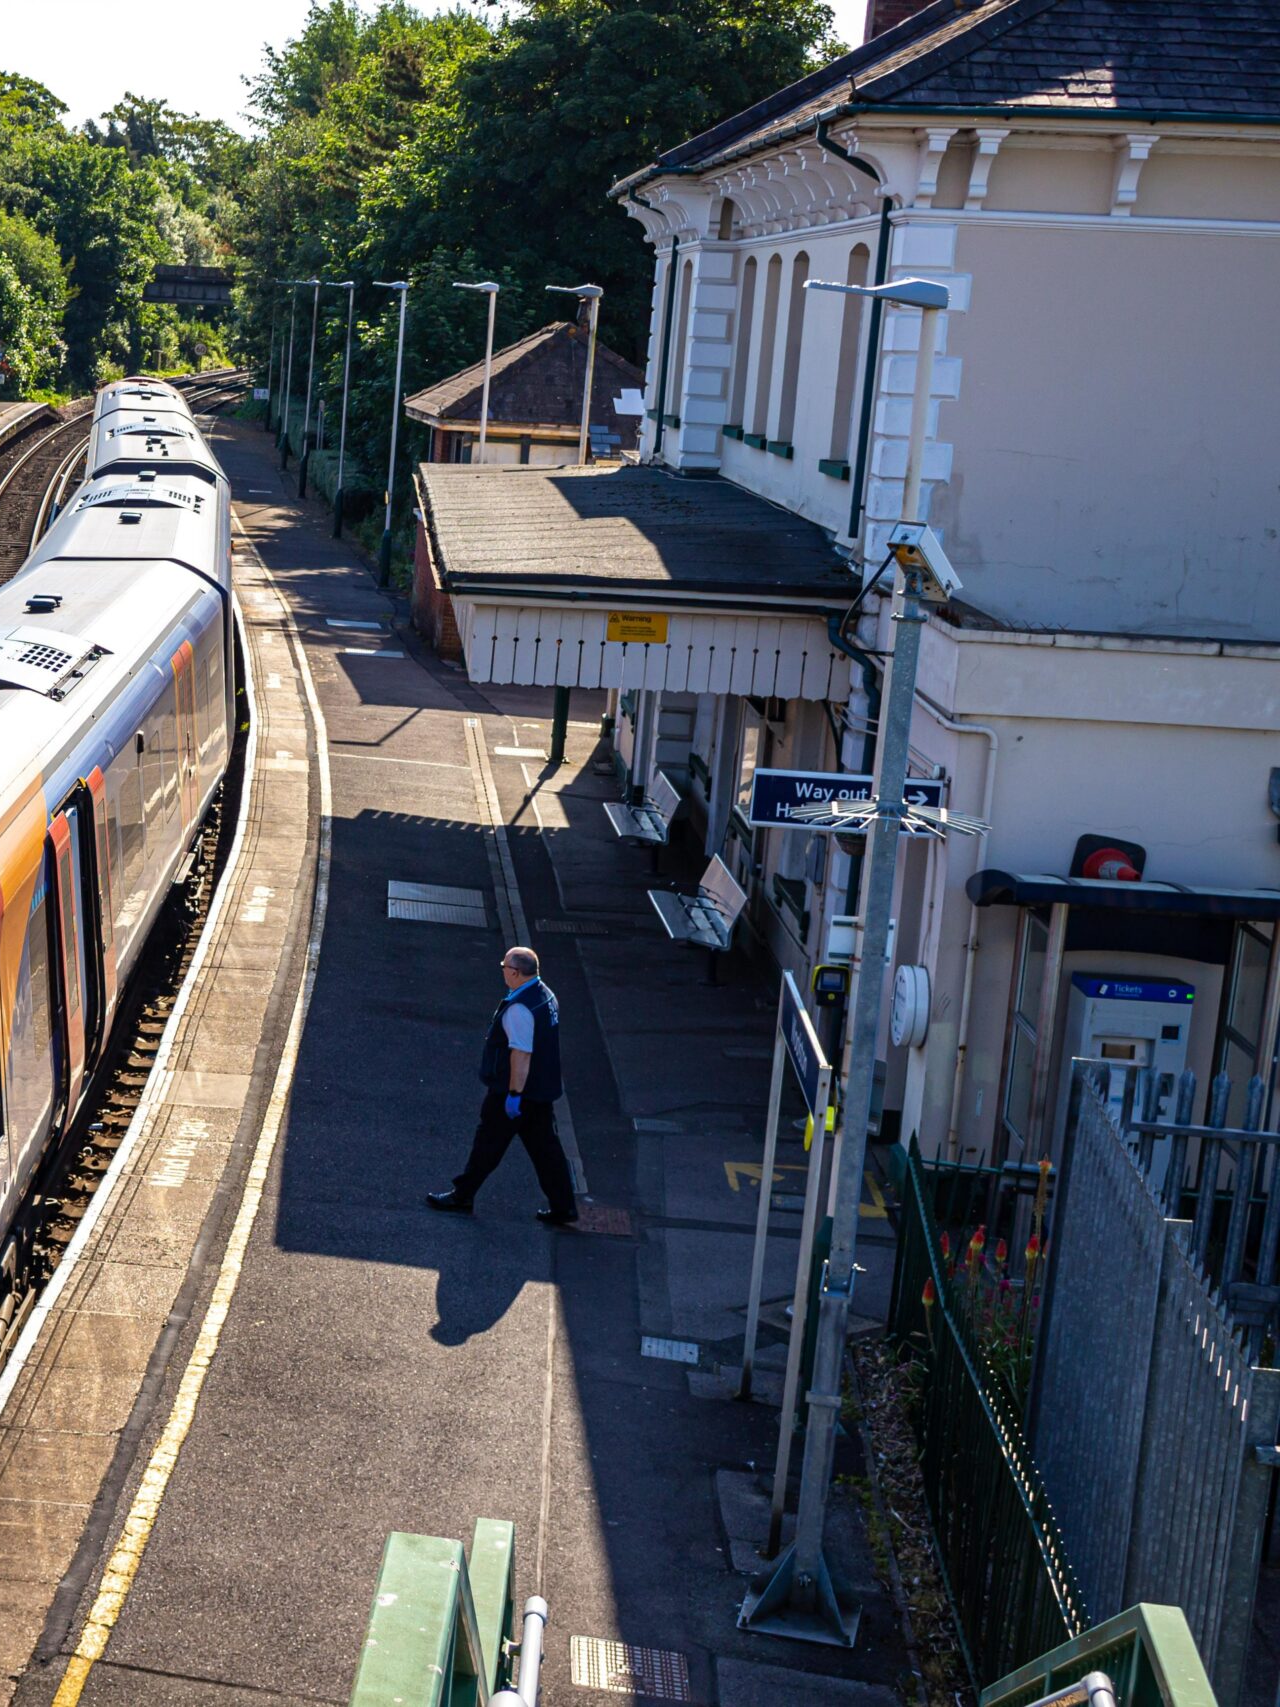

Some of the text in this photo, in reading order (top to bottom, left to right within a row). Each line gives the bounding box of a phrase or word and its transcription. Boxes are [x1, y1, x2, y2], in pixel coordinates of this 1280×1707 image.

[622, 615, 652, 624] Warning
[795, 781, 869, 803] Way out
[1114, 984, 1143, 994] Tickets
